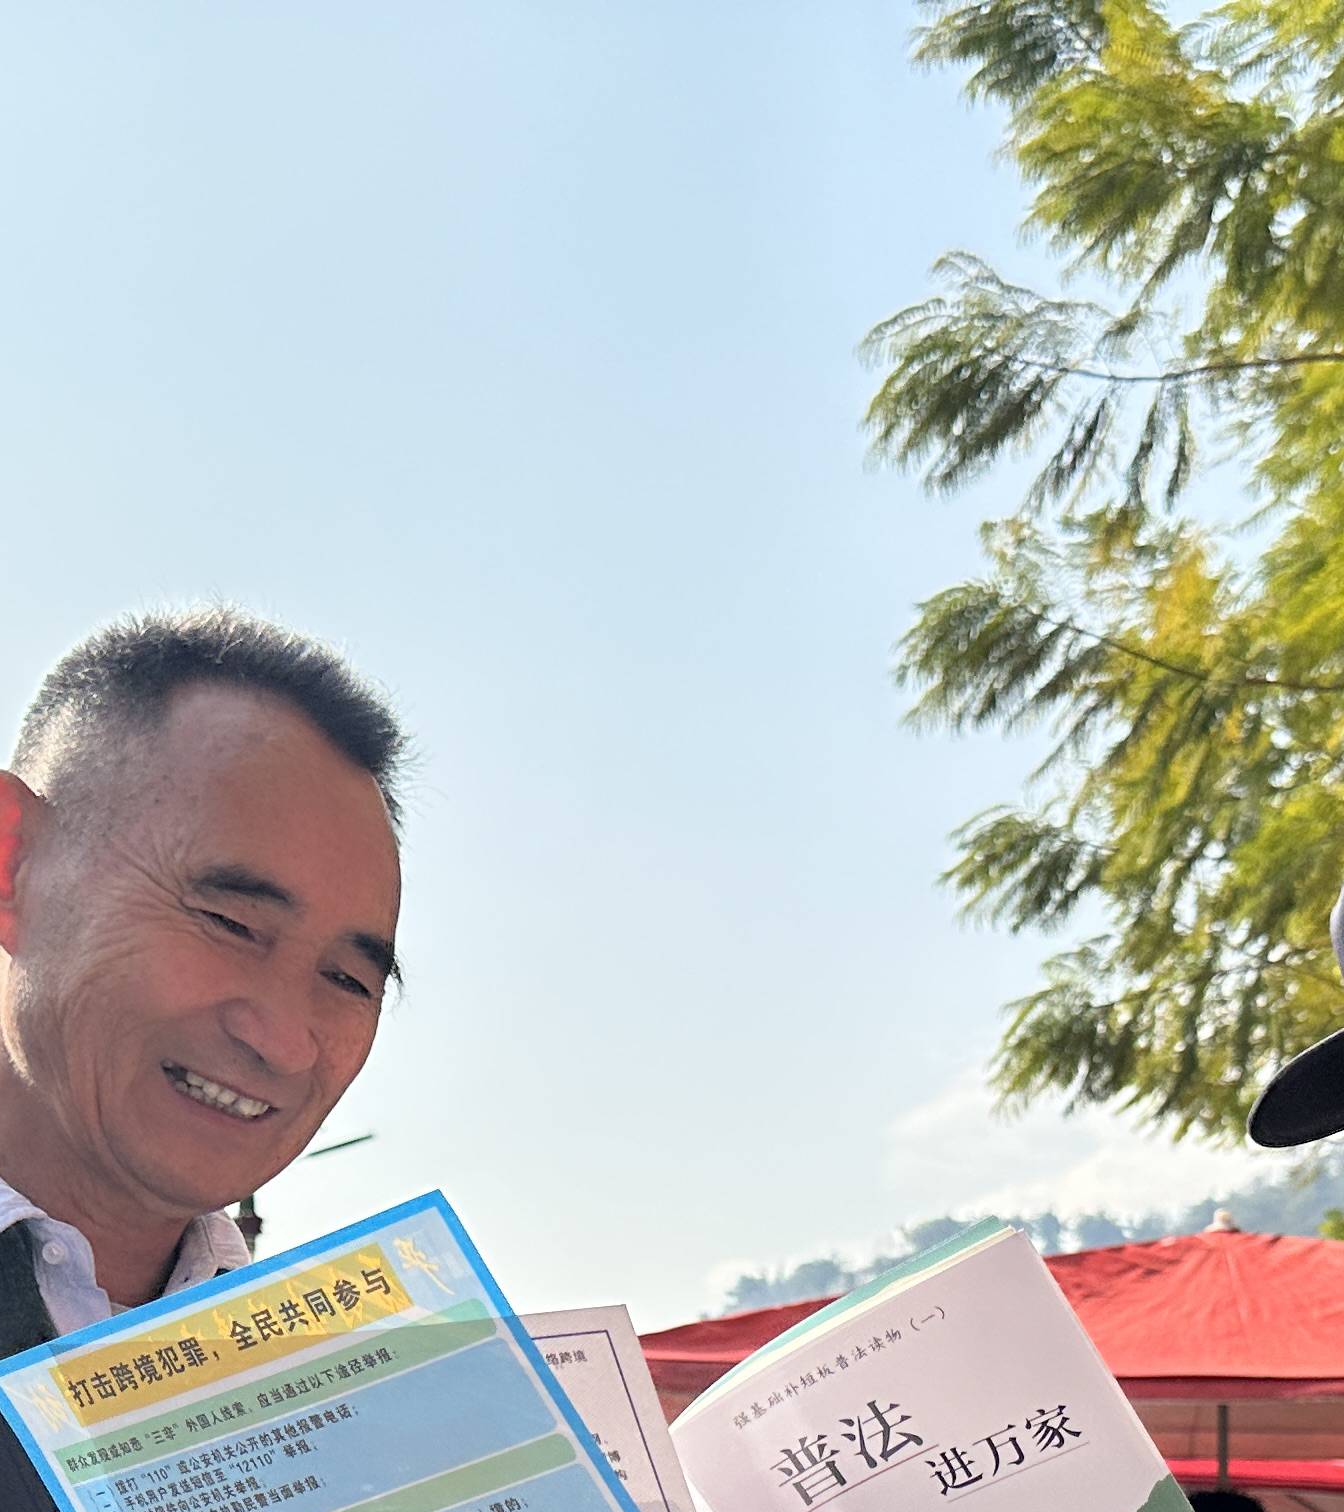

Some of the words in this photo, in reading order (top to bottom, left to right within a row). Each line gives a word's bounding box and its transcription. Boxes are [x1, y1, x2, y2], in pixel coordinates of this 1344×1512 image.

[63, 1264, 395, 1410] 打击跨境犯罪，全民共同参与
[769, 1399, 925, 1507] 普法
[924, 1404, 1083, 1497] 进万家
